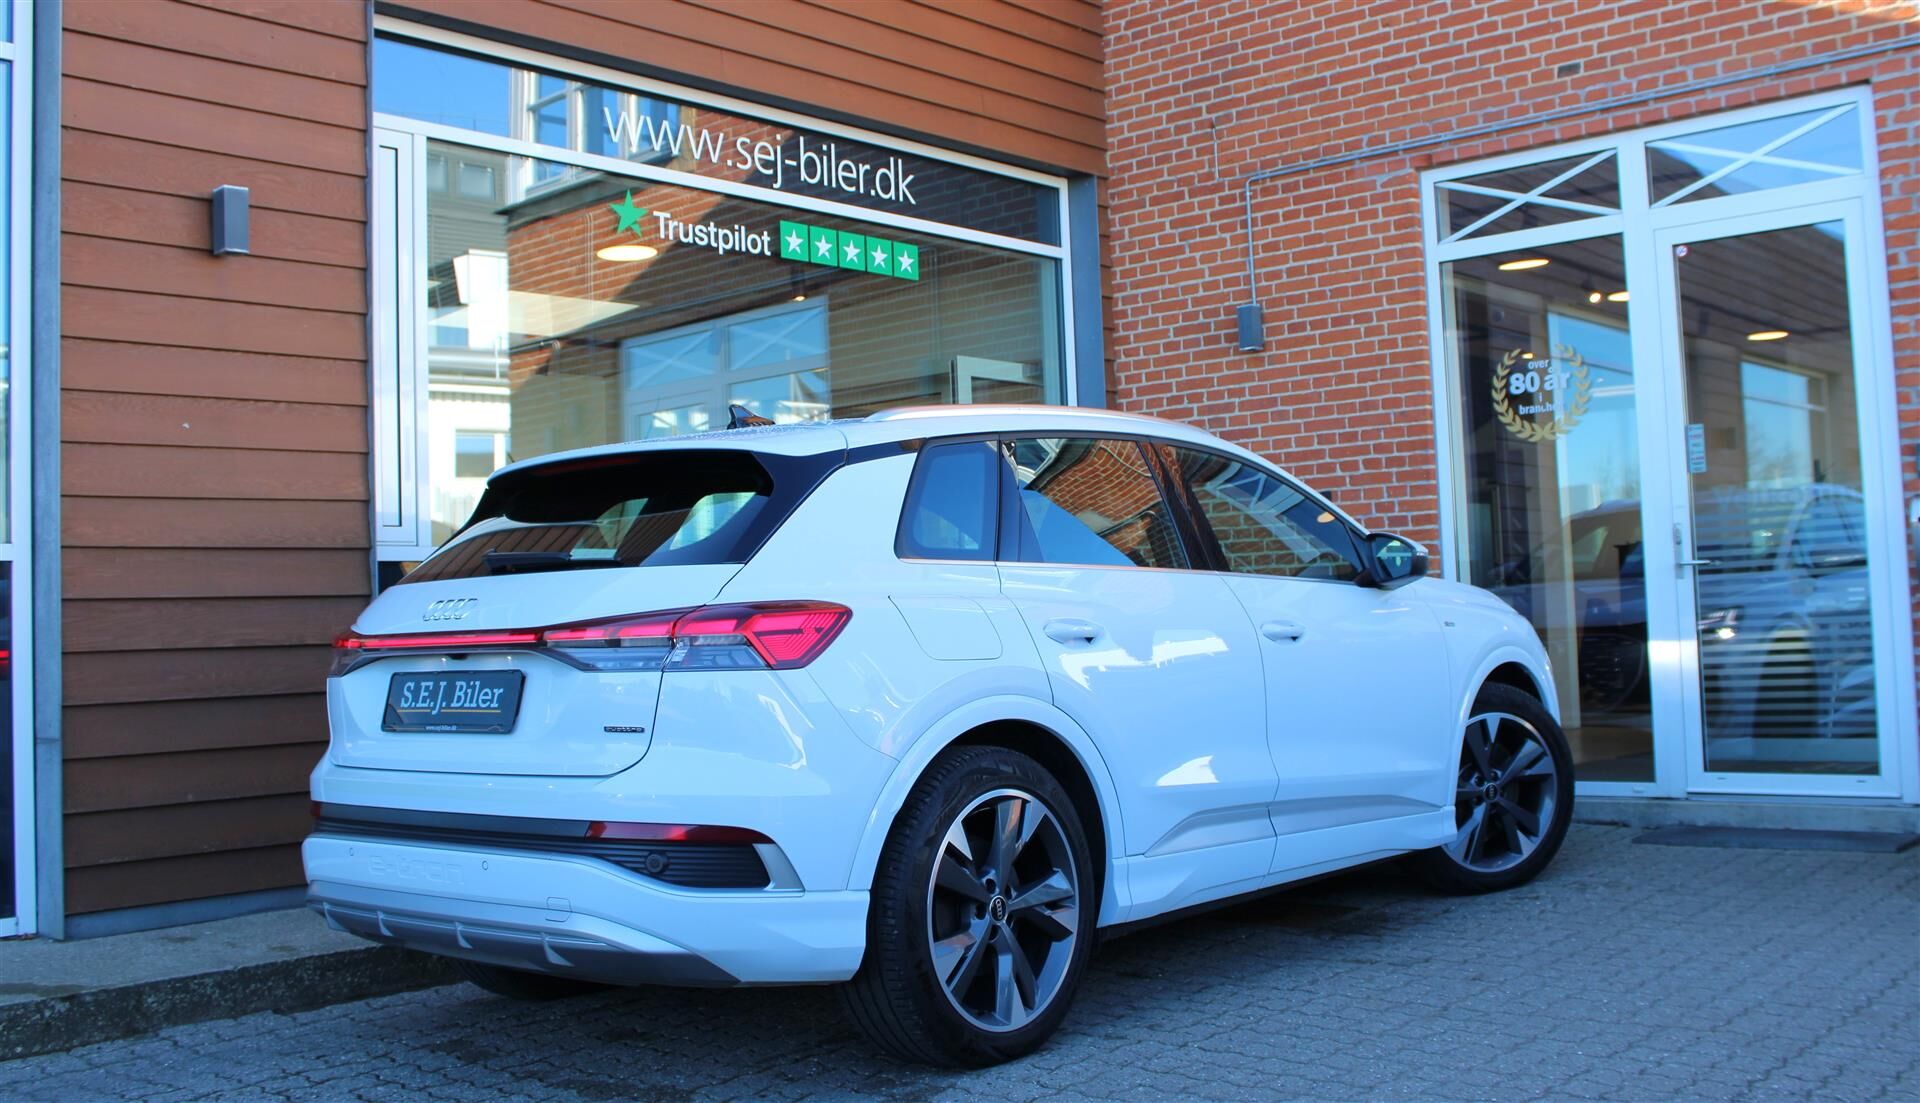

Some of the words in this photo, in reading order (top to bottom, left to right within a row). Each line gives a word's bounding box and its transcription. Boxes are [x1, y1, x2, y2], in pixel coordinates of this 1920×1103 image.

[604, 107, 916, 205] www.sej-biler.dk
[653, 210, 772, 256] Trustpilot
[1528, 360, 1549, 369] over
[1509, 371, 1540, 395] 80
[400, 681, 447, 715] S.E.J.
[450, 680, 504, 708] Biler
